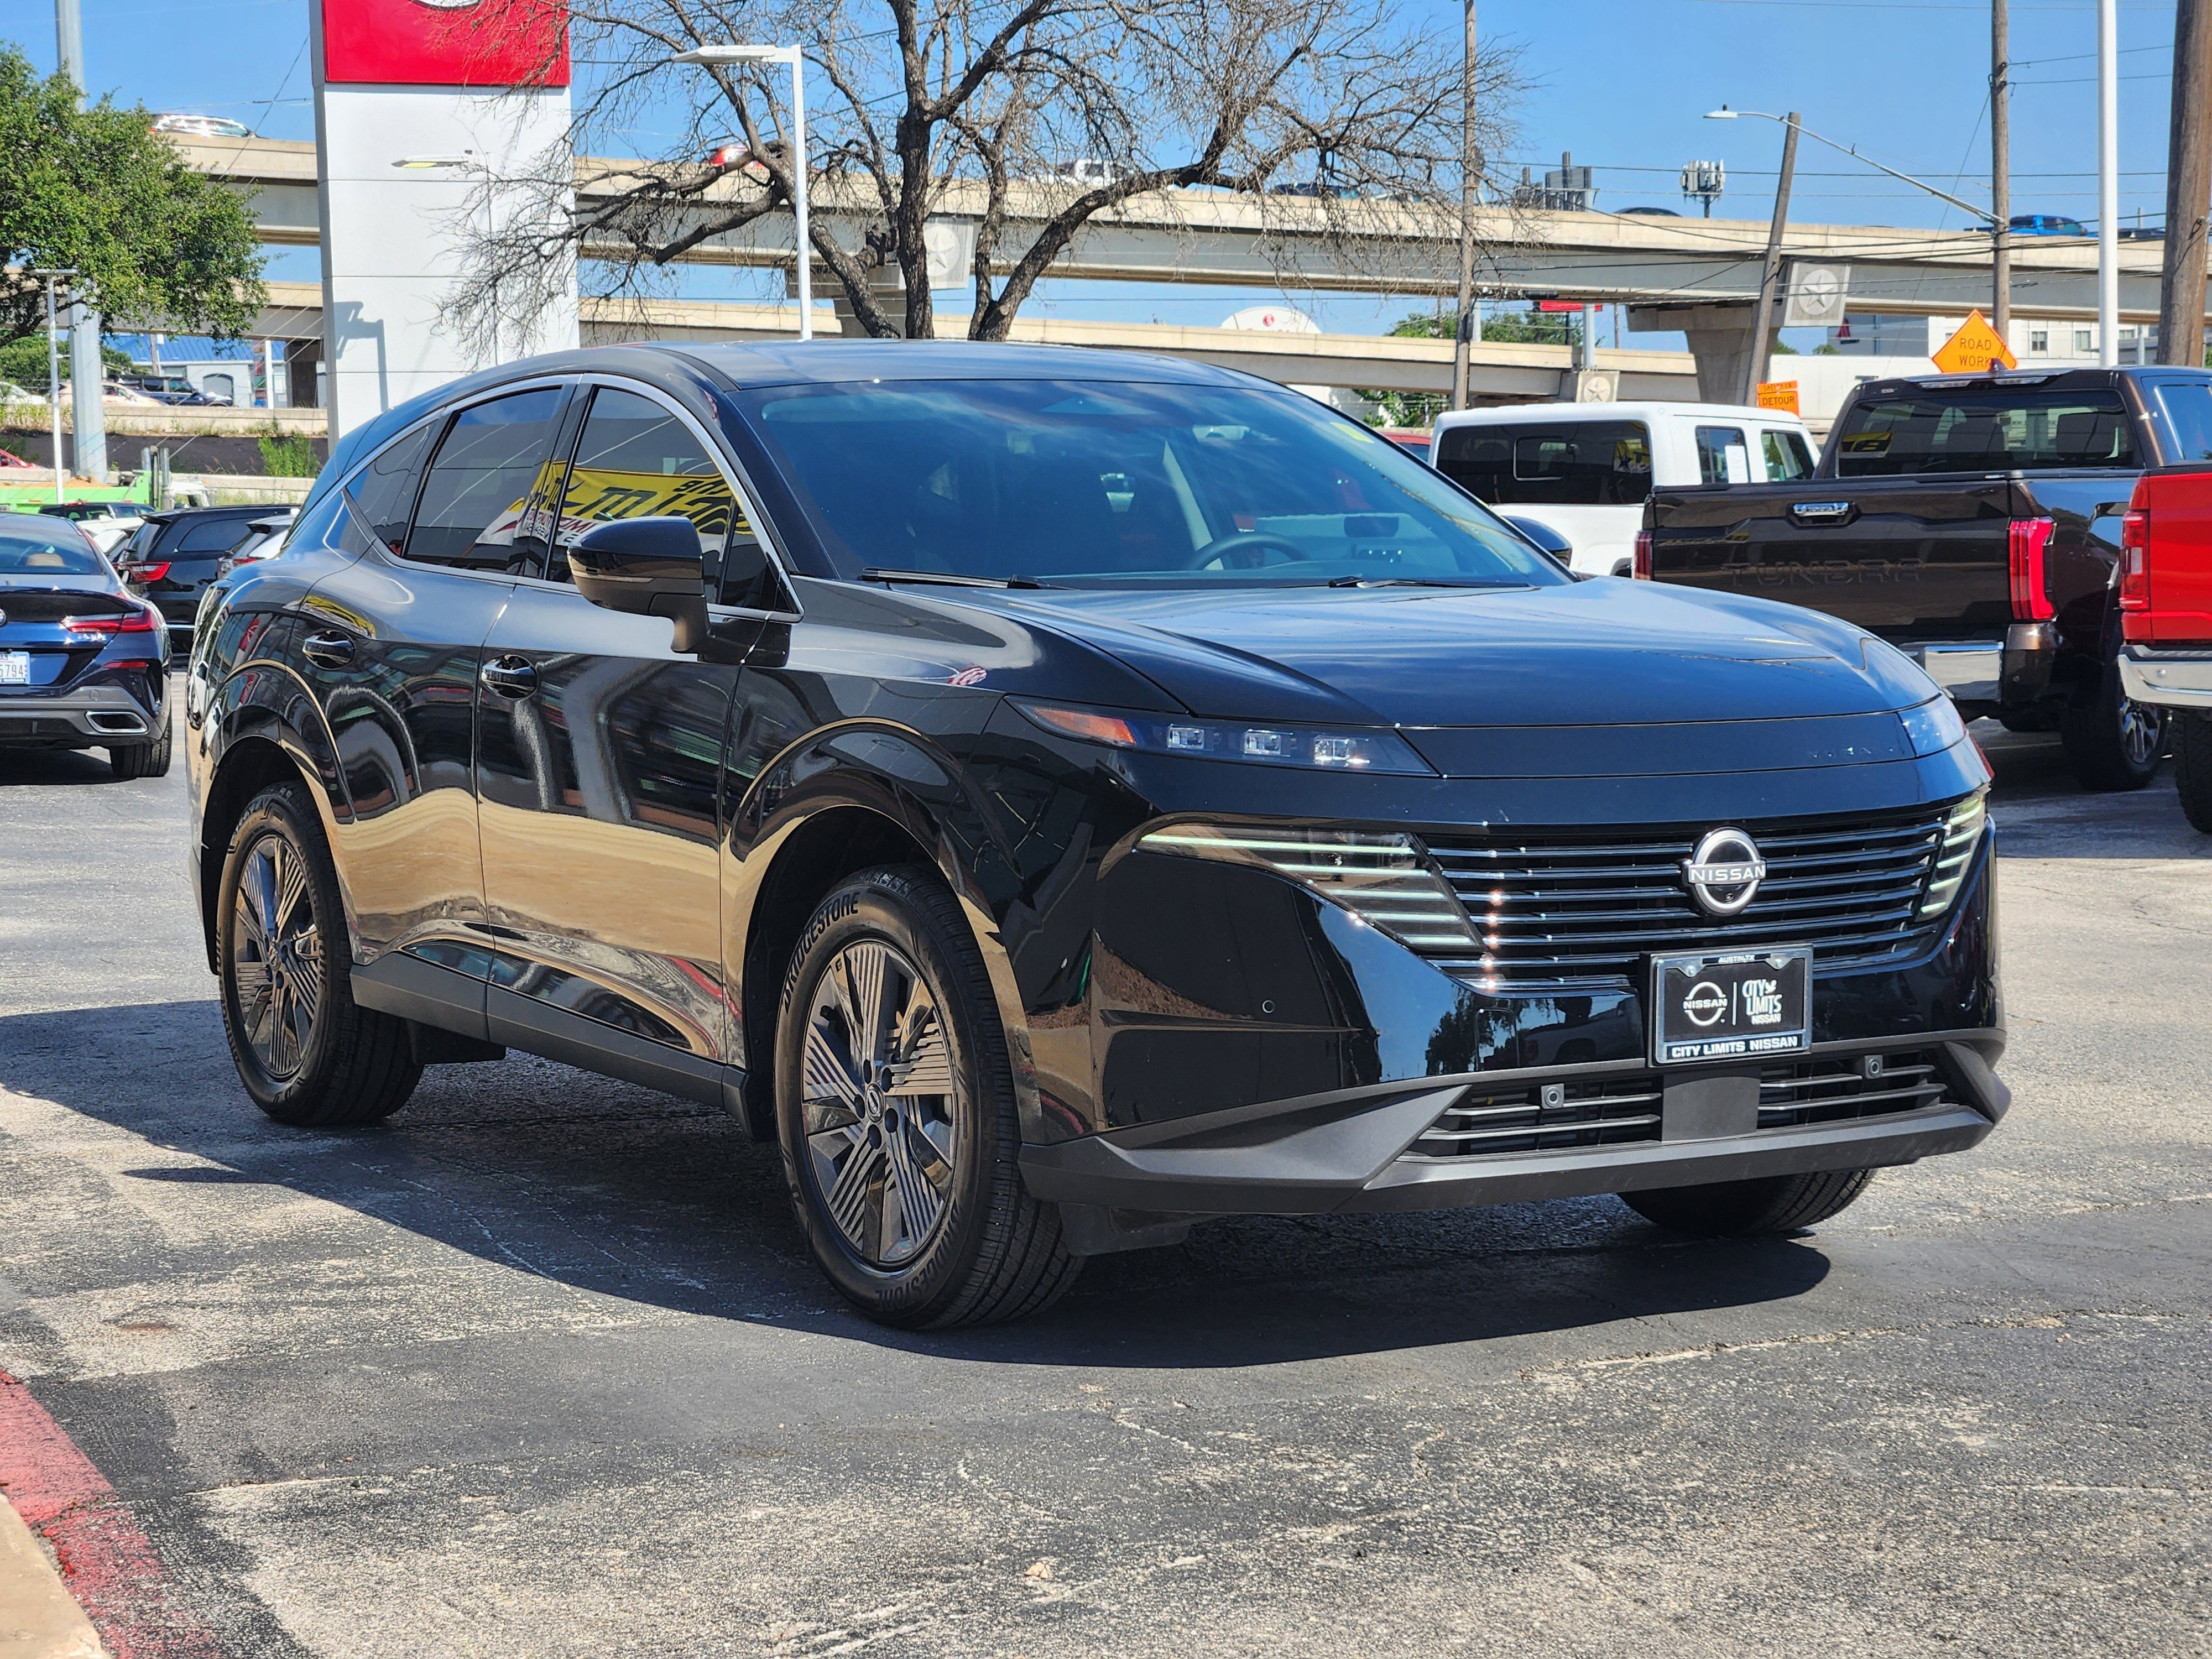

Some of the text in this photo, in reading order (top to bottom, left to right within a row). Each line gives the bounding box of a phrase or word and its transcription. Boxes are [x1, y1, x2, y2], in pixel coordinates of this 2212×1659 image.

[1960, 338, 1992, 351] ROAD
[1959, 354, 1991, 368] WORK
[1762, 396, 1795, 406] DETOUR
[1721, 557, 1926, 587] TUNDRA
[1691, 864, 1766, 881] NISSAN
[782, 891, 861, 1015] BRIDGESTONE
[1742, 979, 1767, 998] CITY
[1683, 998, 1728, 1010] NISSAN
[1746, 994, 1783, 1016] LIMITS
[1751, 1013, 1781, 1025] NISSAN
[1671, 1036, 1798, 1058] CITY LIMITS NISSAN
